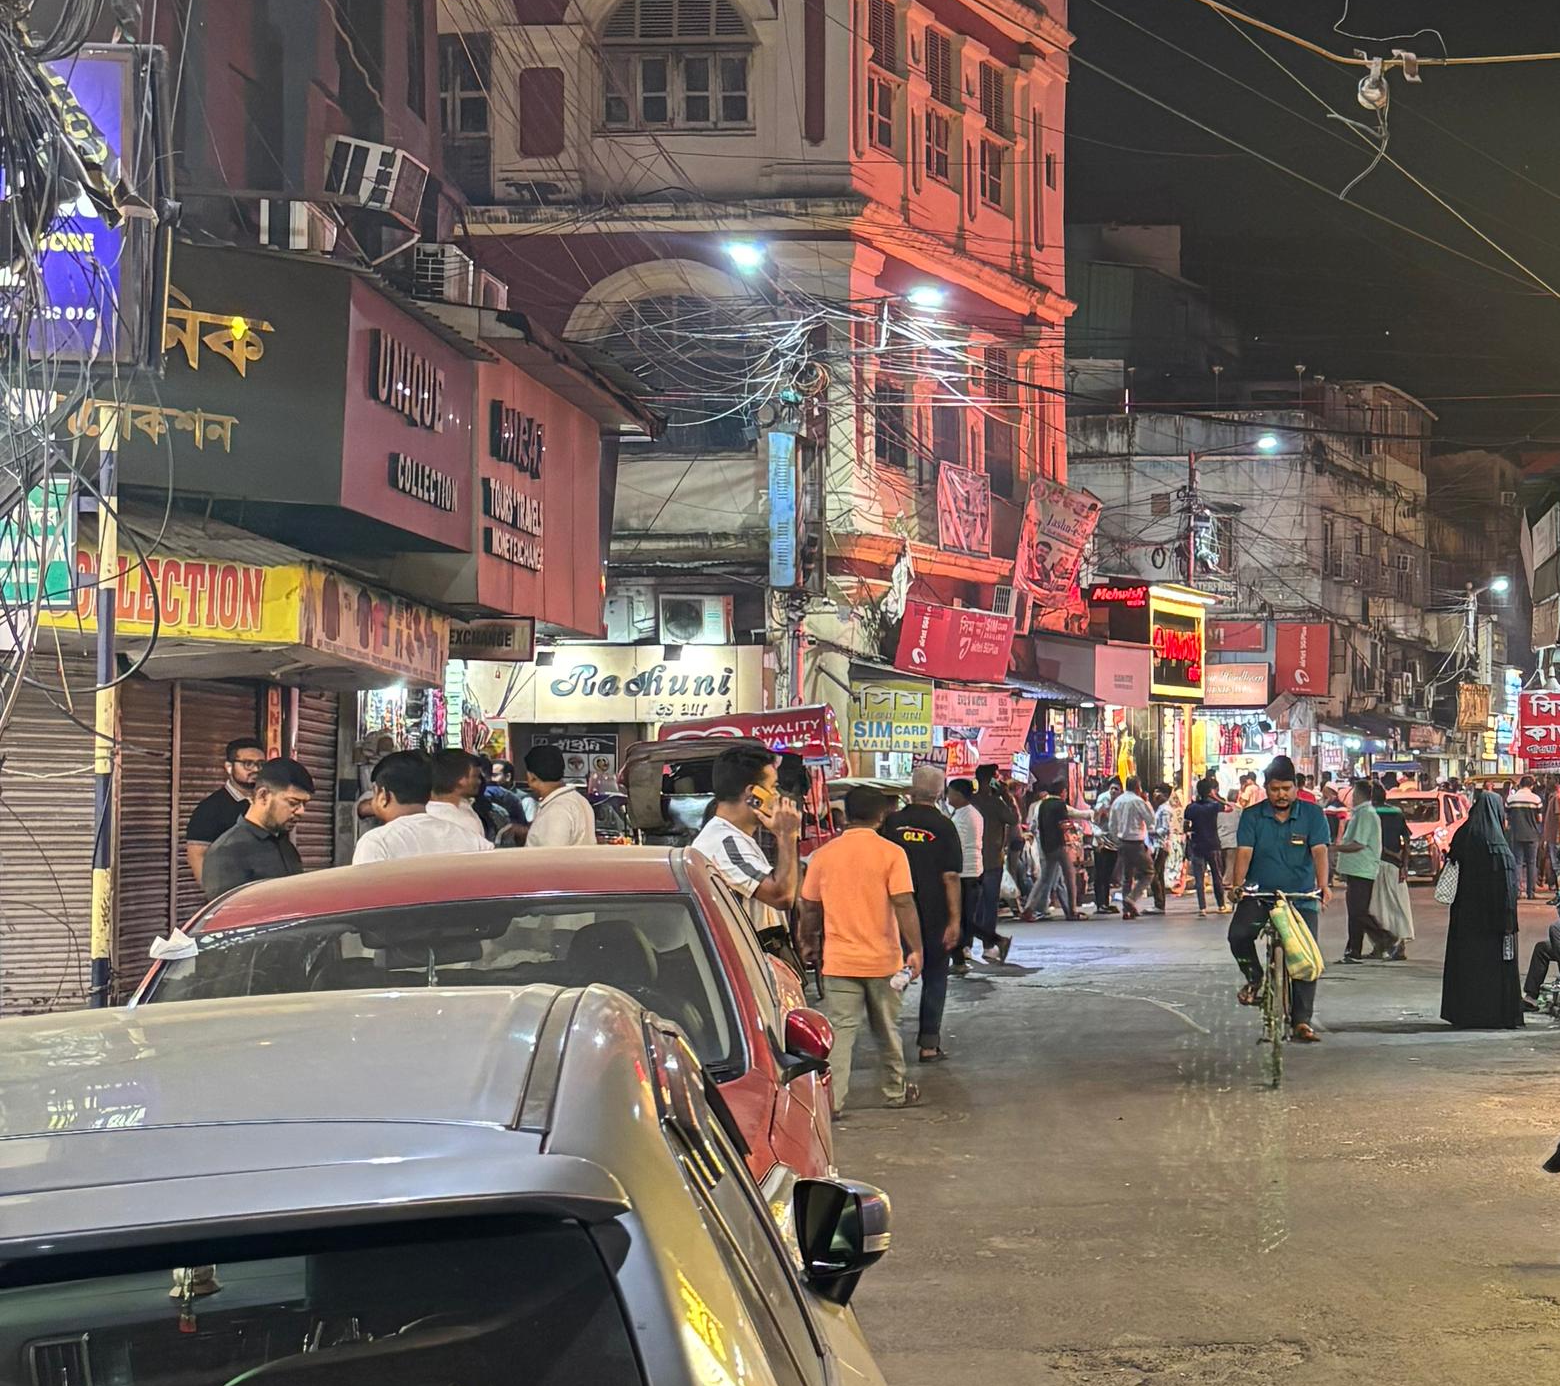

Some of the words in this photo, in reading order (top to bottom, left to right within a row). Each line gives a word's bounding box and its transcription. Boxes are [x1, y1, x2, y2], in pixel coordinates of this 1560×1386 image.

[373, 329, 446, 434] UNIQUE
[394, 452, 459, 513] COLLECTION
[751, 719, 820, 737] KWALITY
[854, 721, 892, 738] SIM
[894, 725, 928, 736] CARD
[853, 739, 928, 750] AVAILABLE
